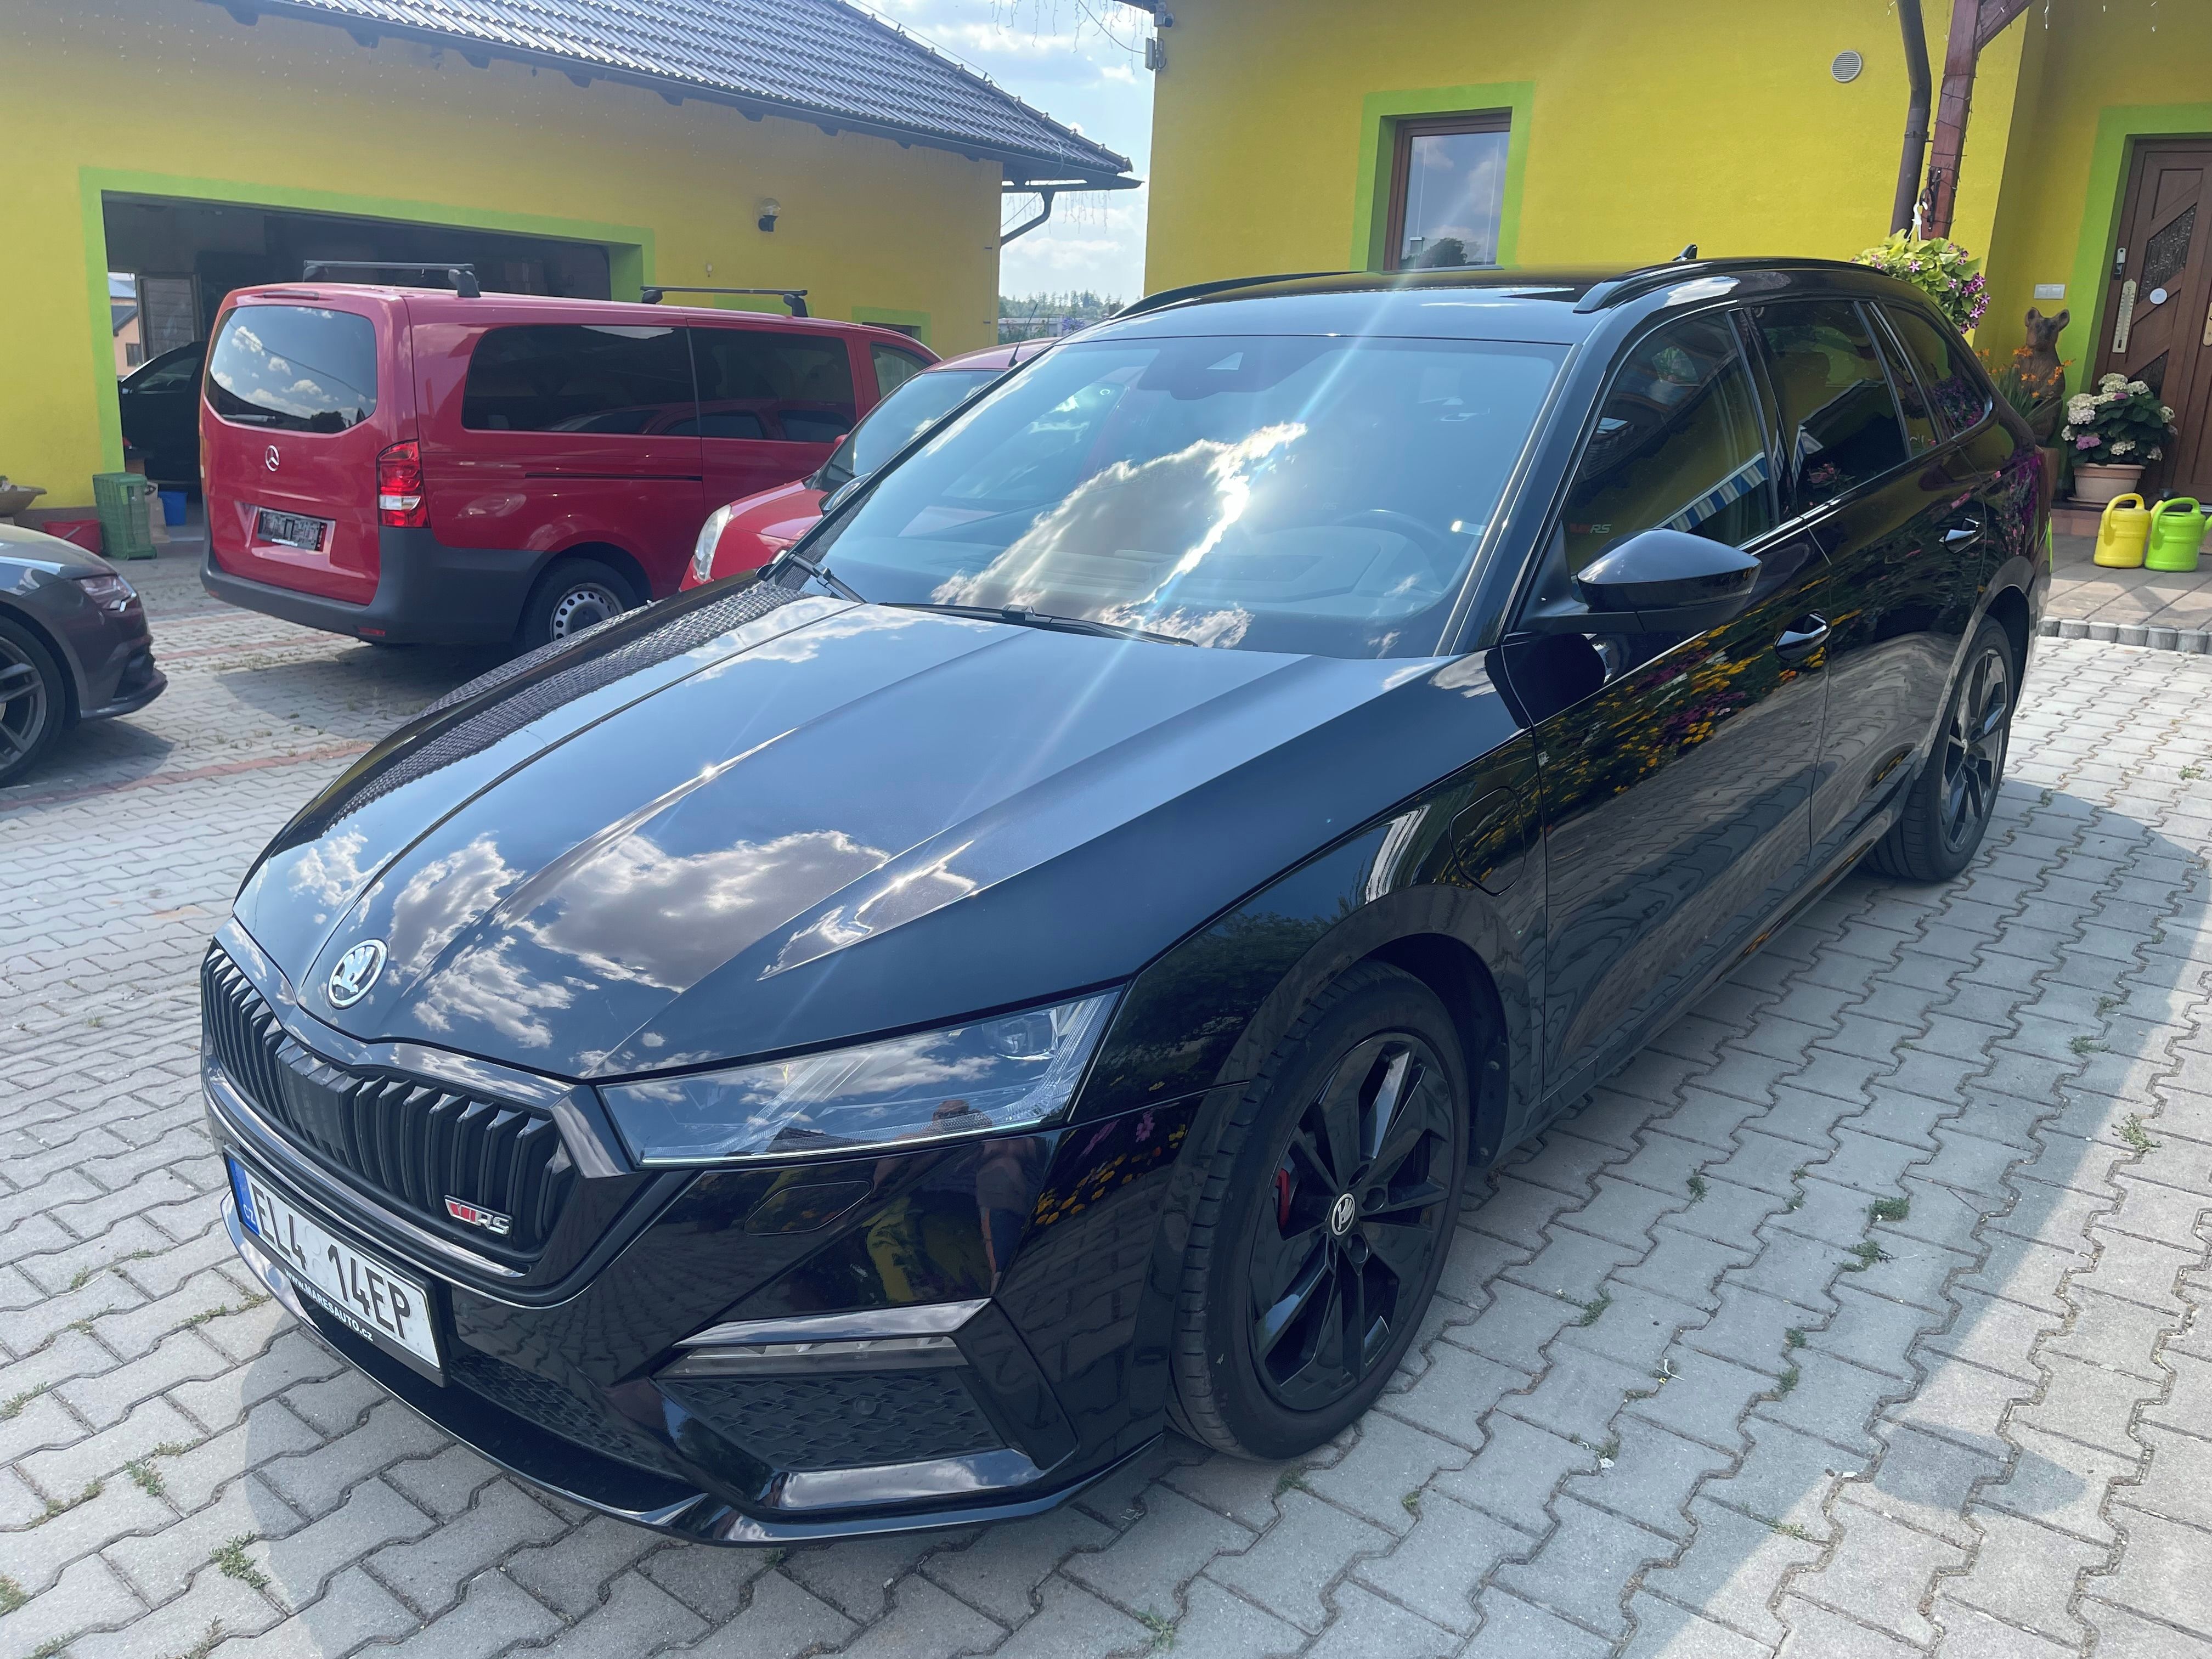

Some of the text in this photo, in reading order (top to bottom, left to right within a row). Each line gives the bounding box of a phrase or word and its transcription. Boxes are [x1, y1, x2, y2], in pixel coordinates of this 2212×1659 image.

[243, 1204, 256, 1225] CZ
[251, 1181, 410, 1340] EL4 14EP
[284, 1268, 374, 1342] www.MARESAUTO.cz
